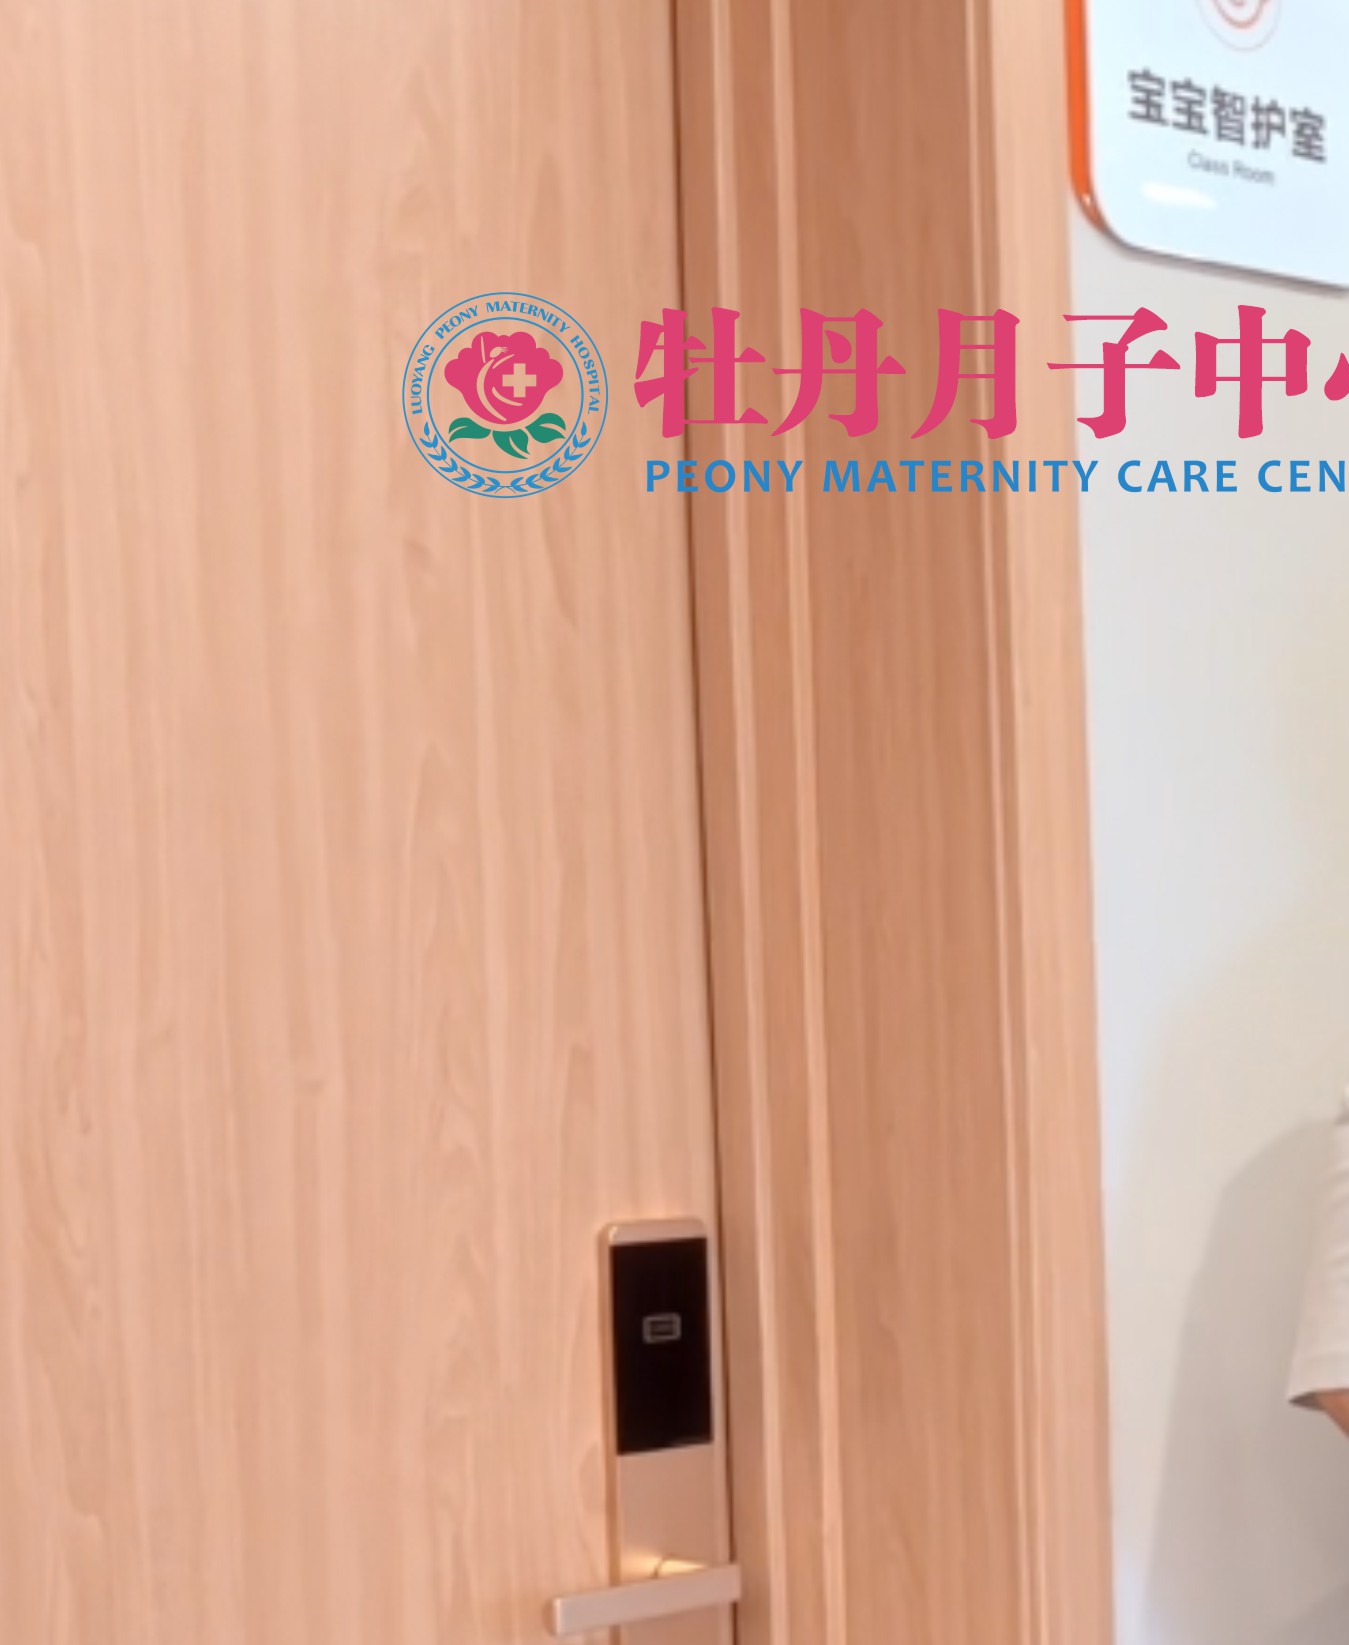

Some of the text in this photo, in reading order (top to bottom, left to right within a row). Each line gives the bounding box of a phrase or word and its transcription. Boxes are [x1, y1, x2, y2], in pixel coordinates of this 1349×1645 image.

[1127, 67, 1327, 163] 宝宝智护室
[1187, 149, 1275, 185] Class Room
